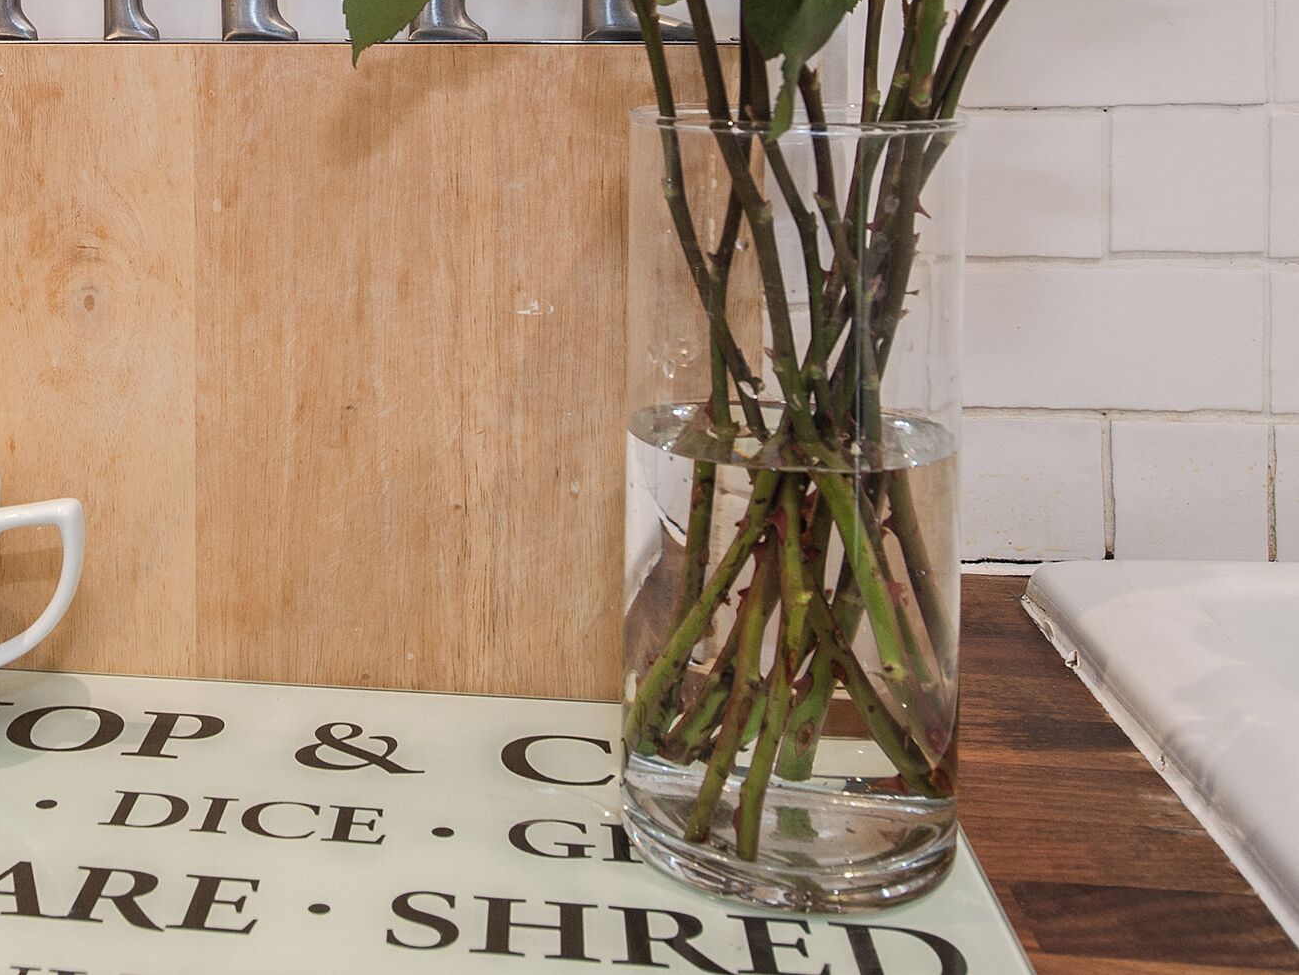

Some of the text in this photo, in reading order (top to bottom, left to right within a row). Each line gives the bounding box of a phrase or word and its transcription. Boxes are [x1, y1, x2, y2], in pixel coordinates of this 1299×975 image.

[295, 722, 425, 776] &
[98, 790, 387, 846] DICE
[385, 891, 969, 975] SHRED
